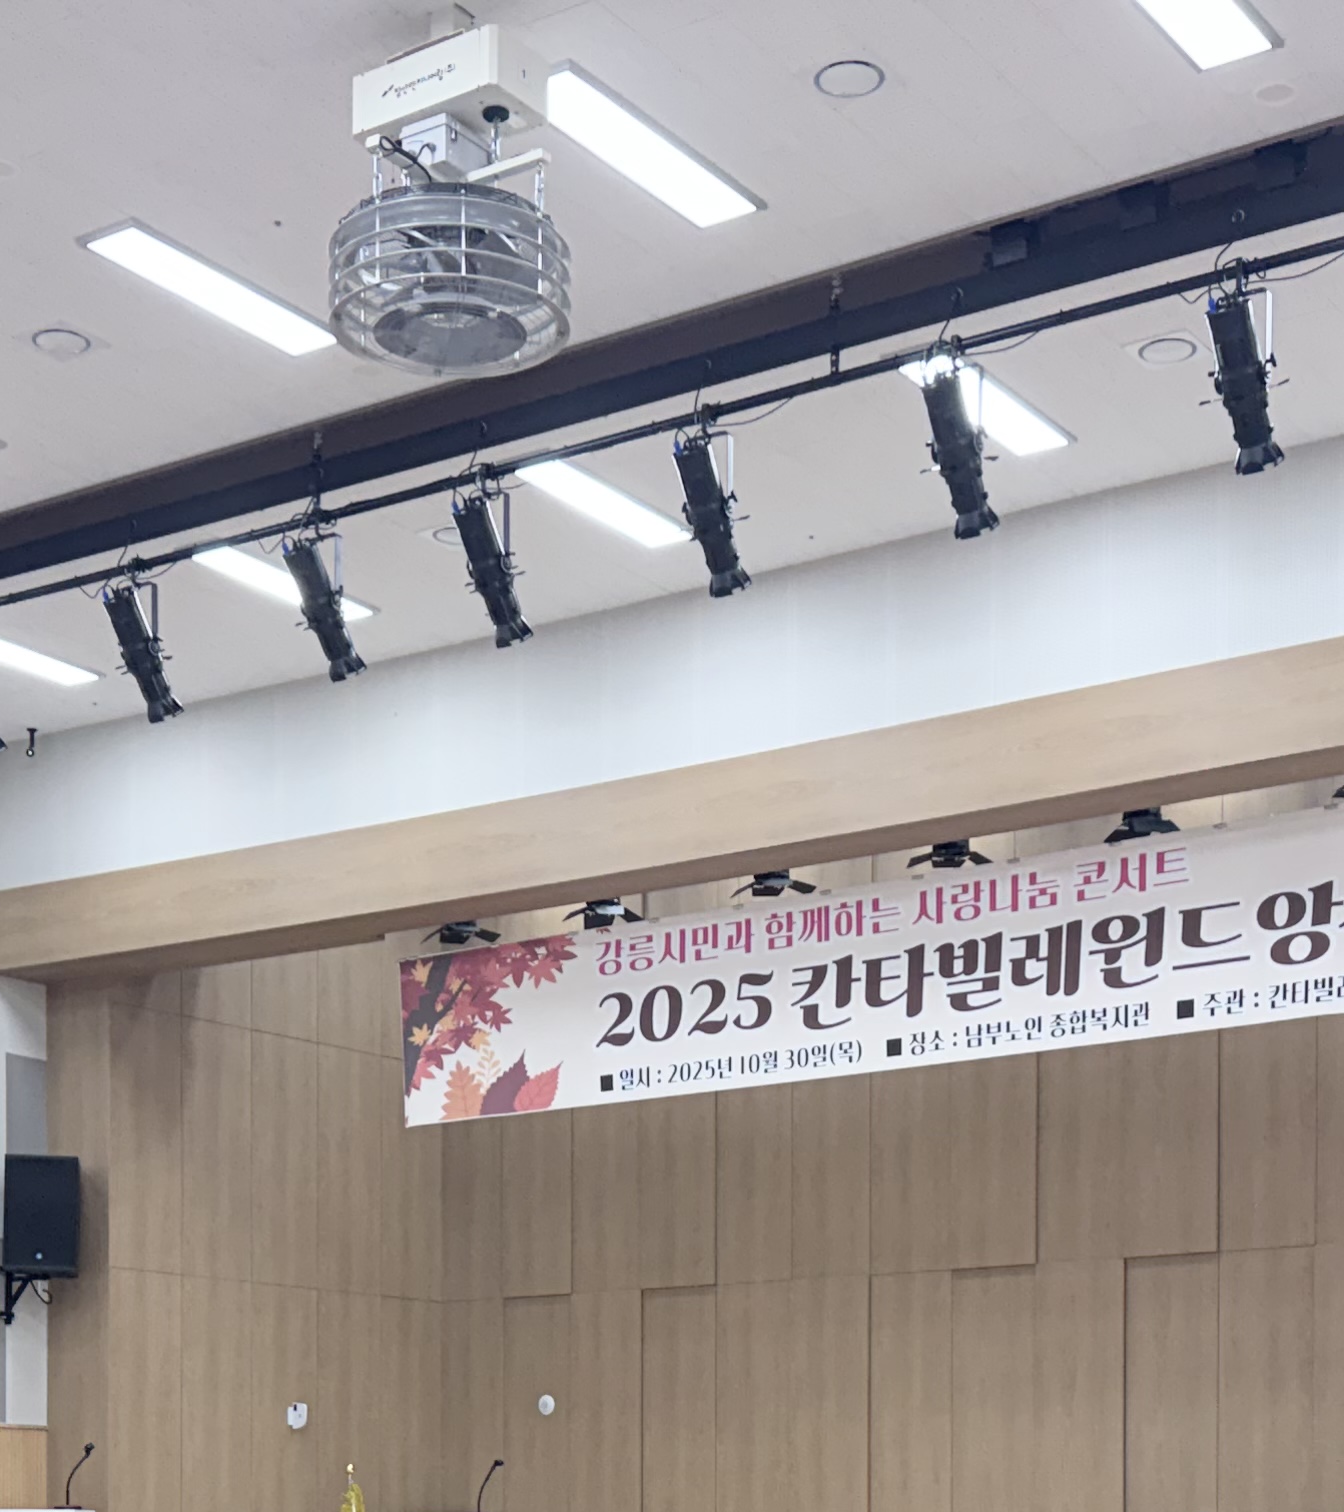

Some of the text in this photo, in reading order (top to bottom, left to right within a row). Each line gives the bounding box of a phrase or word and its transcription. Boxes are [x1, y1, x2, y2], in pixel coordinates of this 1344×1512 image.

[596, 847, 1190, 976] 강릉시민과 함께하는 사랑나눔 콘서트
[596, 969, 774, 1048] 2025
[619, 1066, 651, 1091] 일시
[667, 1056, 733, 1084] 2025년
[740, 1050, 780, 1076] 10월
[784, 1038, 863, 1070] 30일(목)
[909, 1031, 946, 1056] 장소
[965, 1016, 1043, 1049] 남부노인
[1049, 1002, 1151, 1039] 종합복지관
[1203, 989, 1245, 1017] 주관
